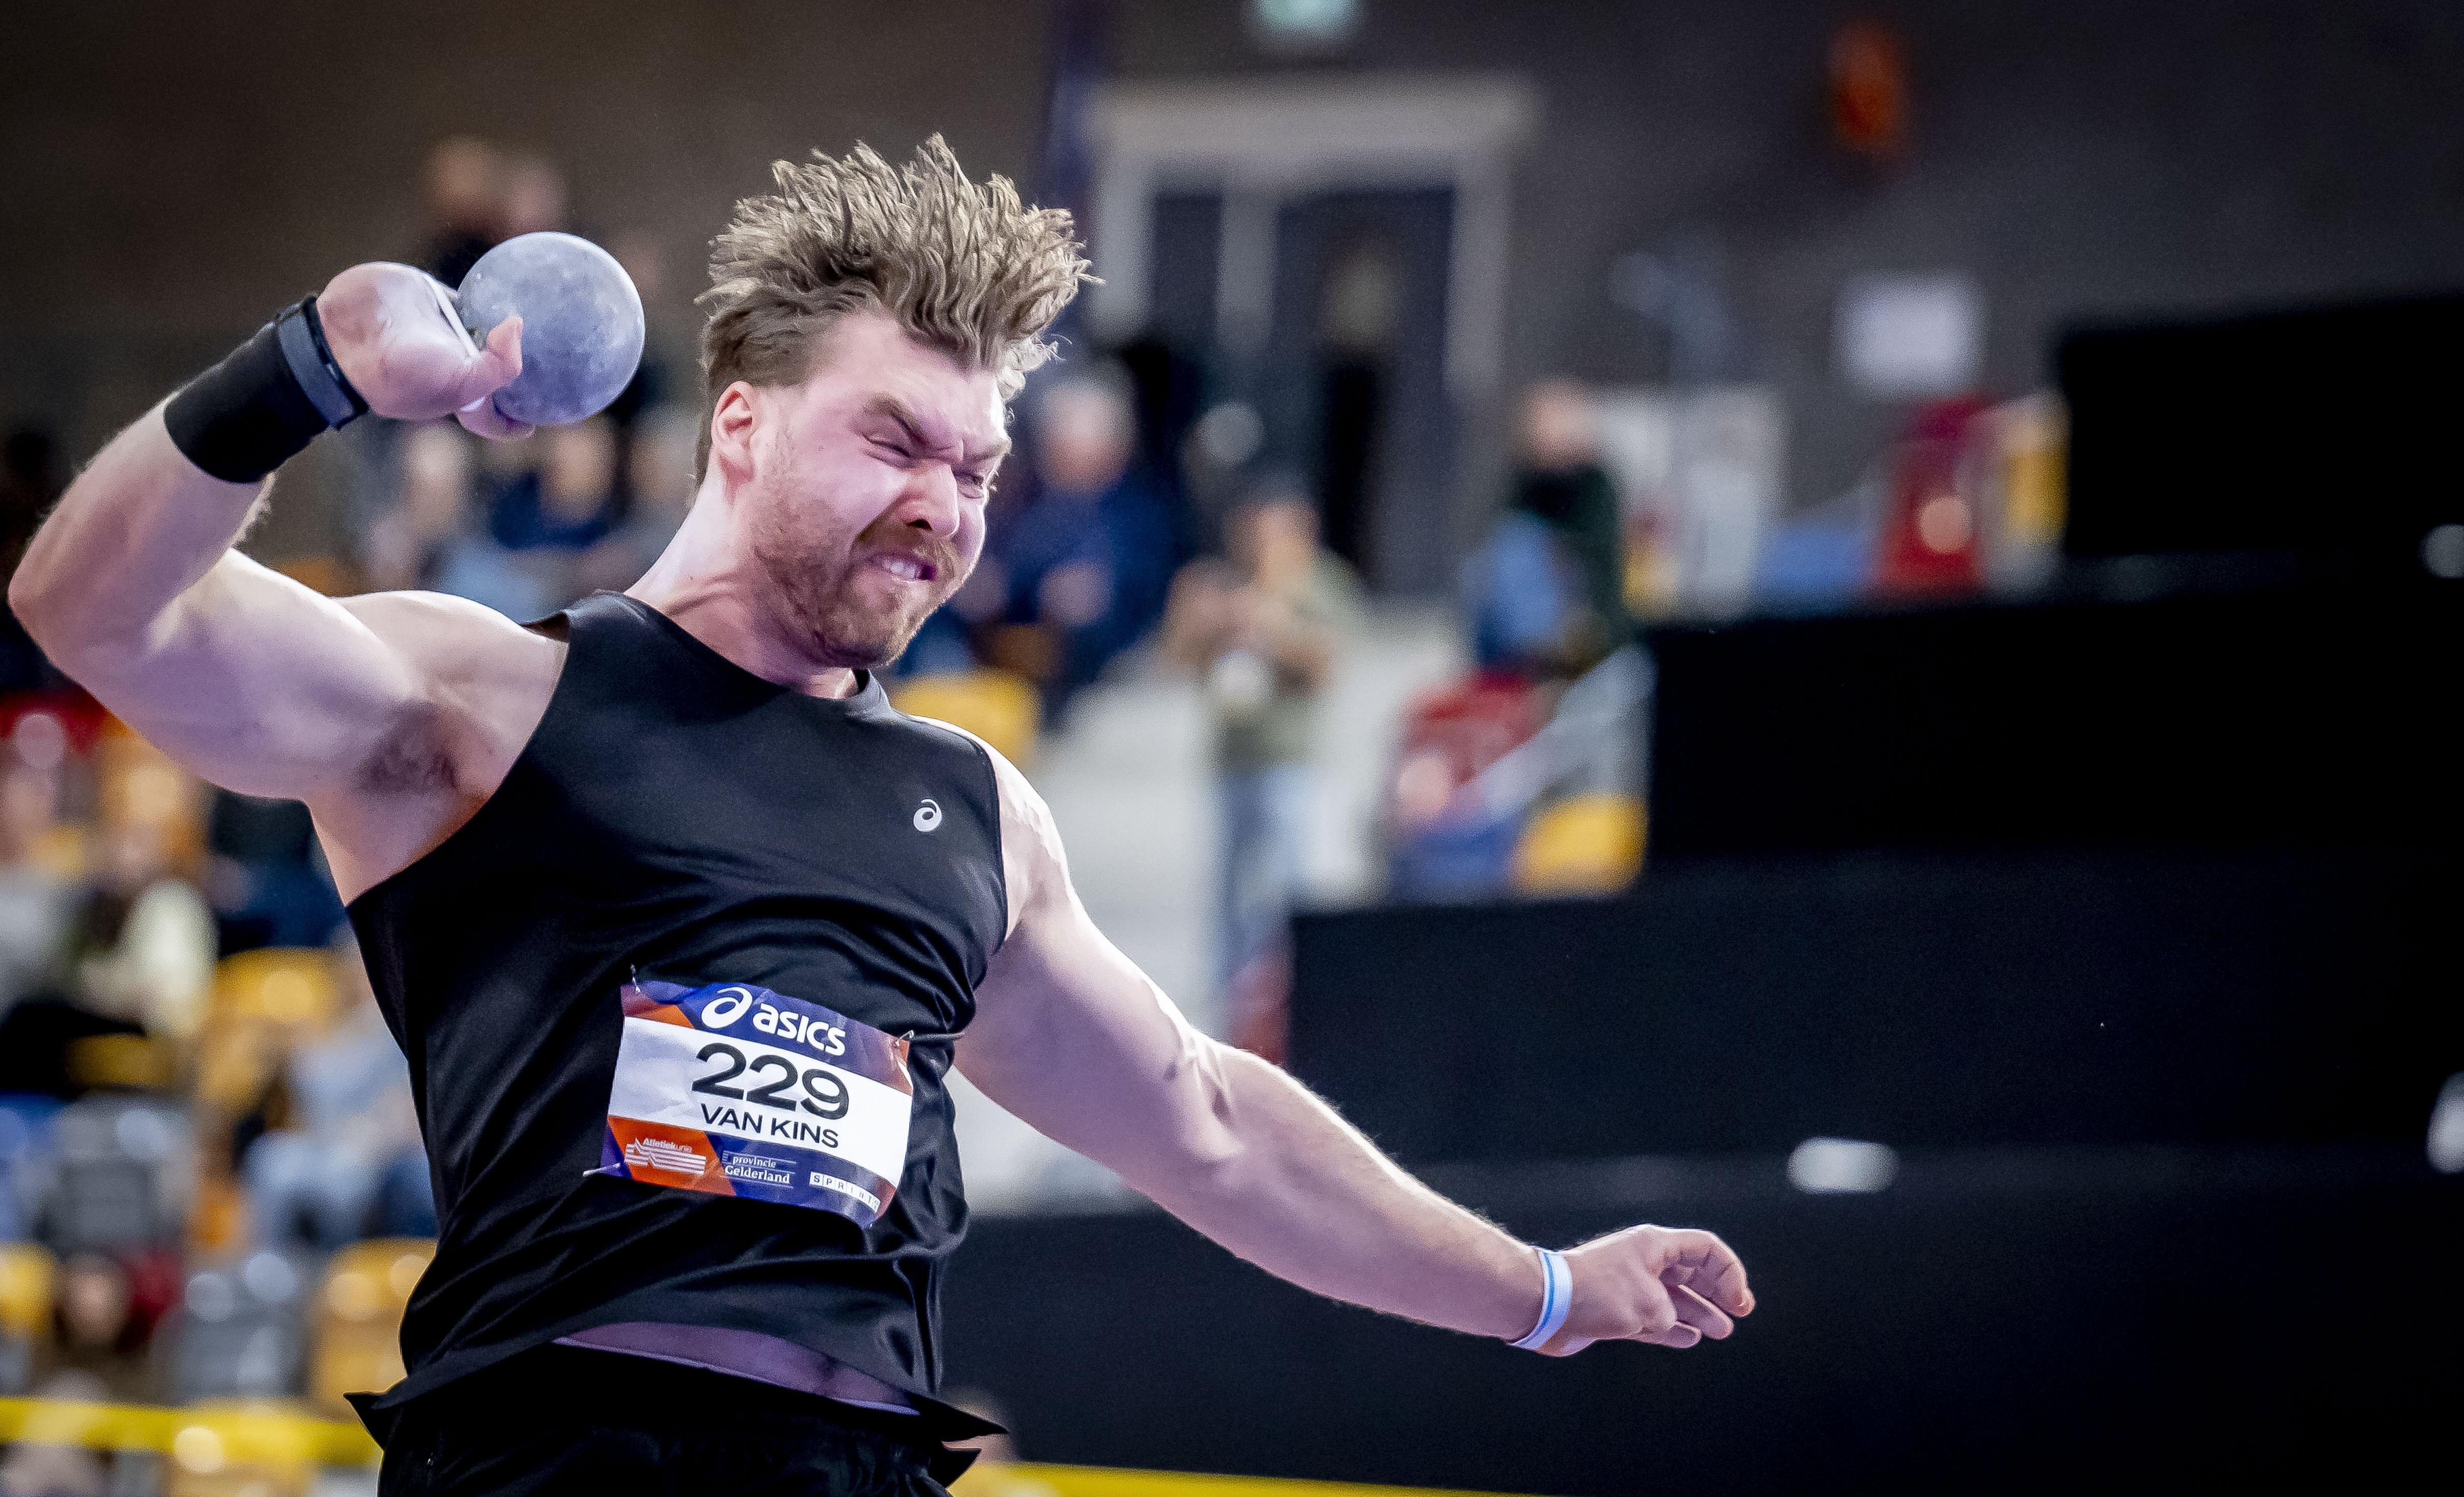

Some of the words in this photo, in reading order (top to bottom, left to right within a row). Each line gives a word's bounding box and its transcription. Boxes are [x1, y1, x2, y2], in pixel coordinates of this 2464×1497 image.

[753, 1003, 845, 1056] asics
[691, 1042, 849, 1120] 229
[701, 1103, 762, 1134] VAN
[770, 1117, 838, 1148] KINS
[725, 1165, 790, 1184] Gelderland
[732, 1156, 776, 1168] provincie
